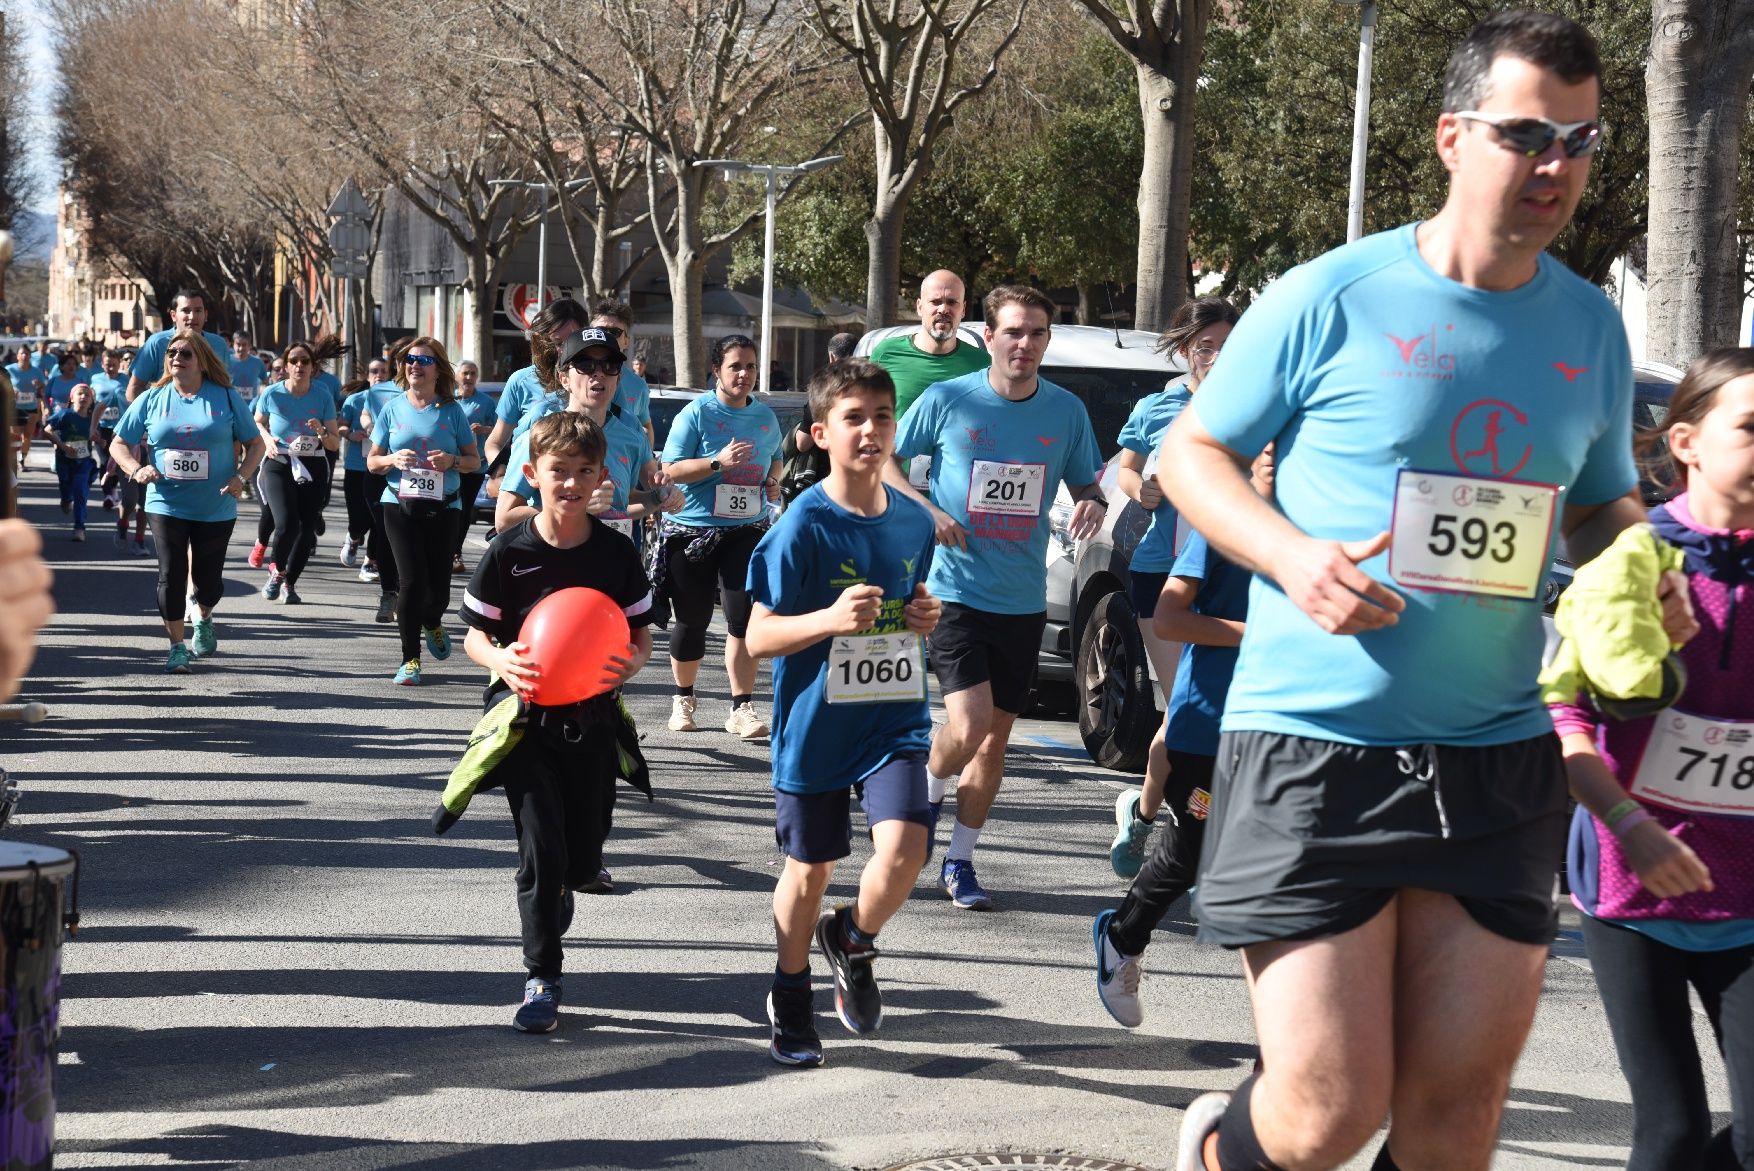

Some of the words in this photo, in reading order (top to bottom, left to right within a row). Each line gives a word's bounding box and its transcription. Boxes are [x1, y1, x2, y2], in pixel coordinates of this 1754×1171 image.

[173, 459, 199, 472] 580
[409, 478, 435, 491] 238
[985, 480, 1027, 501] 201
[729, 496, 747, 510] 35
[1428, 514, 1516, 563] 593
[839, 657, 912, 685] 1060
[1675, 746, 1754, 790] 718
